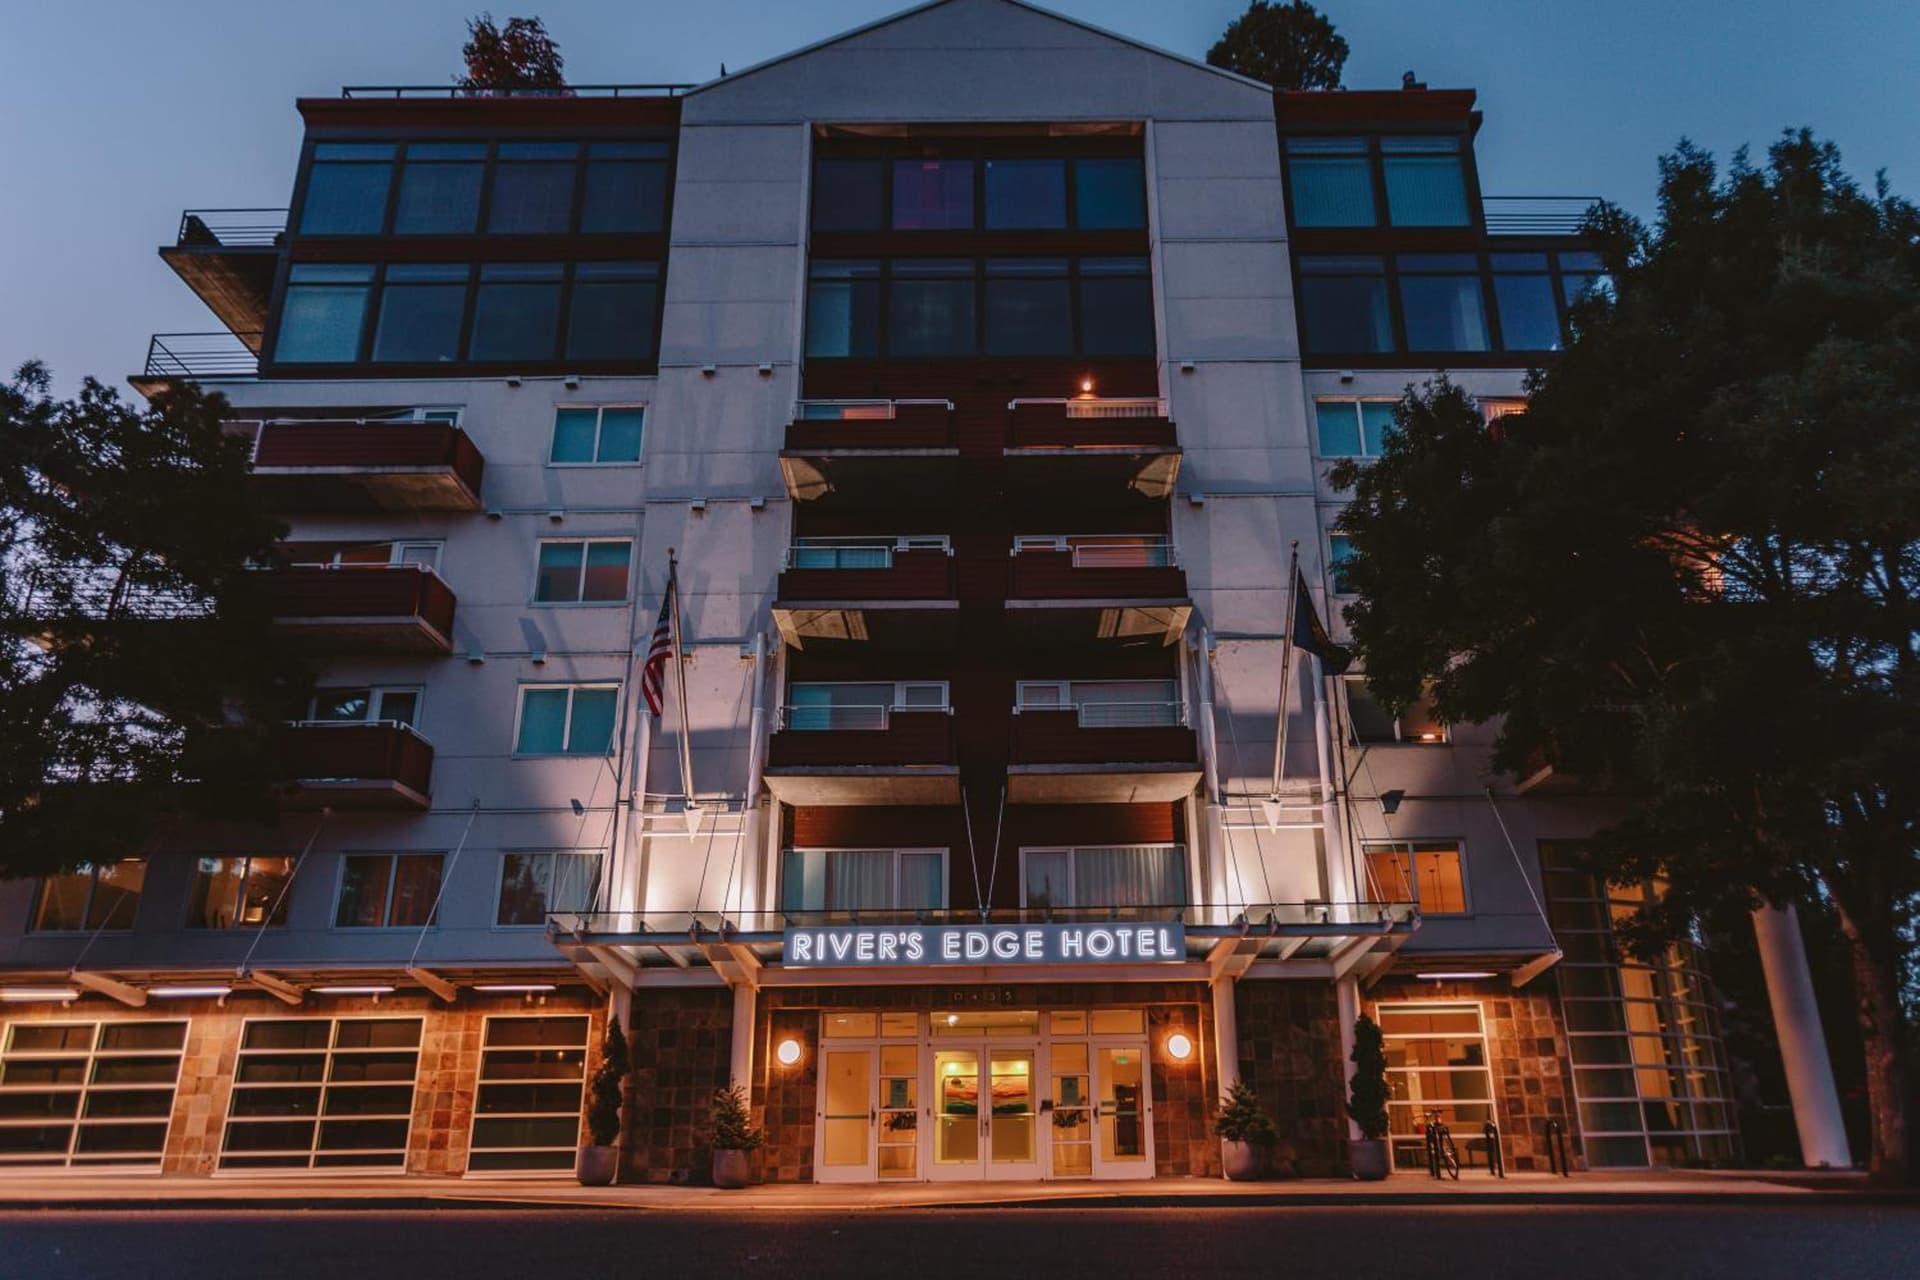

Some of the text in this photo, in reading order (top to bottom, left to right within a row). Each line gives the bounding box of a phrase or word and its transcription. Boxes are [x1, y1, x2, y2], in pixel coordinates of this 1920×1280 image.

[792, 929, 1176, 961] RIVER'S EDGE HOTEL
